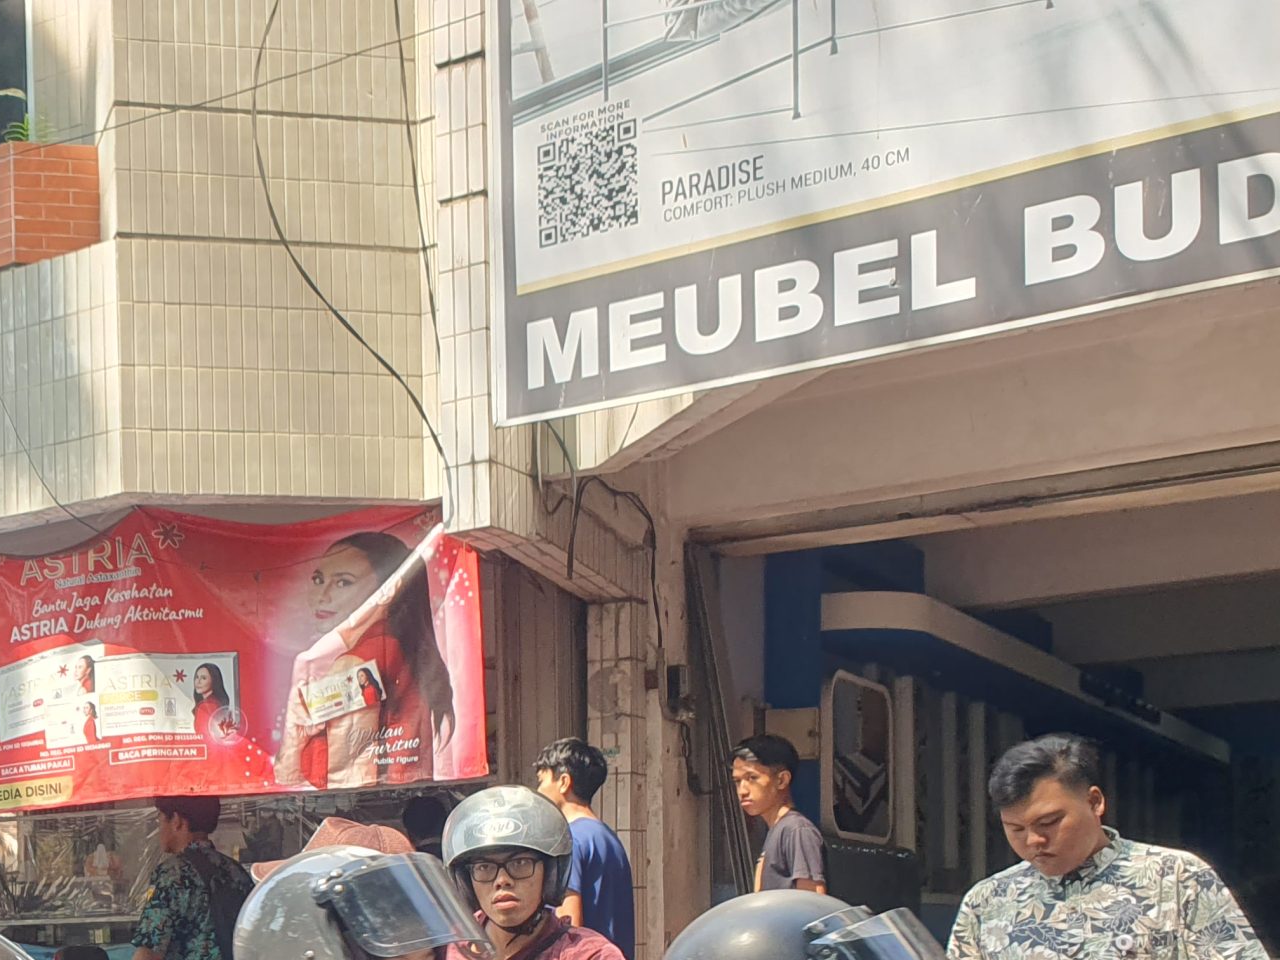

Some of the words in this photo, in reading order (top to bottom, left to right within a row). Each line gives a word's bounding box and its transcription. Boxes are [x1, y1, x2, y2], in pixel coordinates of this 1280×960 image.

[540, 117, 569, 133] SCAN
[572, 110, 595, 124] FOR
[597, 99, 630, 116] MORE
[546, 112, 624, 141] INFORMATION
[661, 155, 765, 206] PARADISE
[663, 195, 734, 223] COMFORT:
[737, 180, 787, 206] PLUSH
[791, 162, 857, 191] MEDIUM,
[861, 155, 881, 172] 40
[884, 147, 911, 167] CM
[526, 230, 976, 390] MEUBEL
[1024, 154, 1280, 286] BUD
[54, 574, 85, 590] Natural
[32, 598, 68, 617] Bantu
[68, 591, 100, 613] Jaga
[104, 583, 173, 606] Kesehatan
[10, 616, 69, 643] ASTRIA
[73, 613, 121, 634] Dukung
[124, 606, 204, 626] Aktivitasmu
[118, 749, 141, 761] BACA
[141, 748, 197, 758] PERINGATAN
[373, 757, 395, 766] Public
[396, 755, 419, 765] Figure
[25, 782, 62, 798] DISINI
